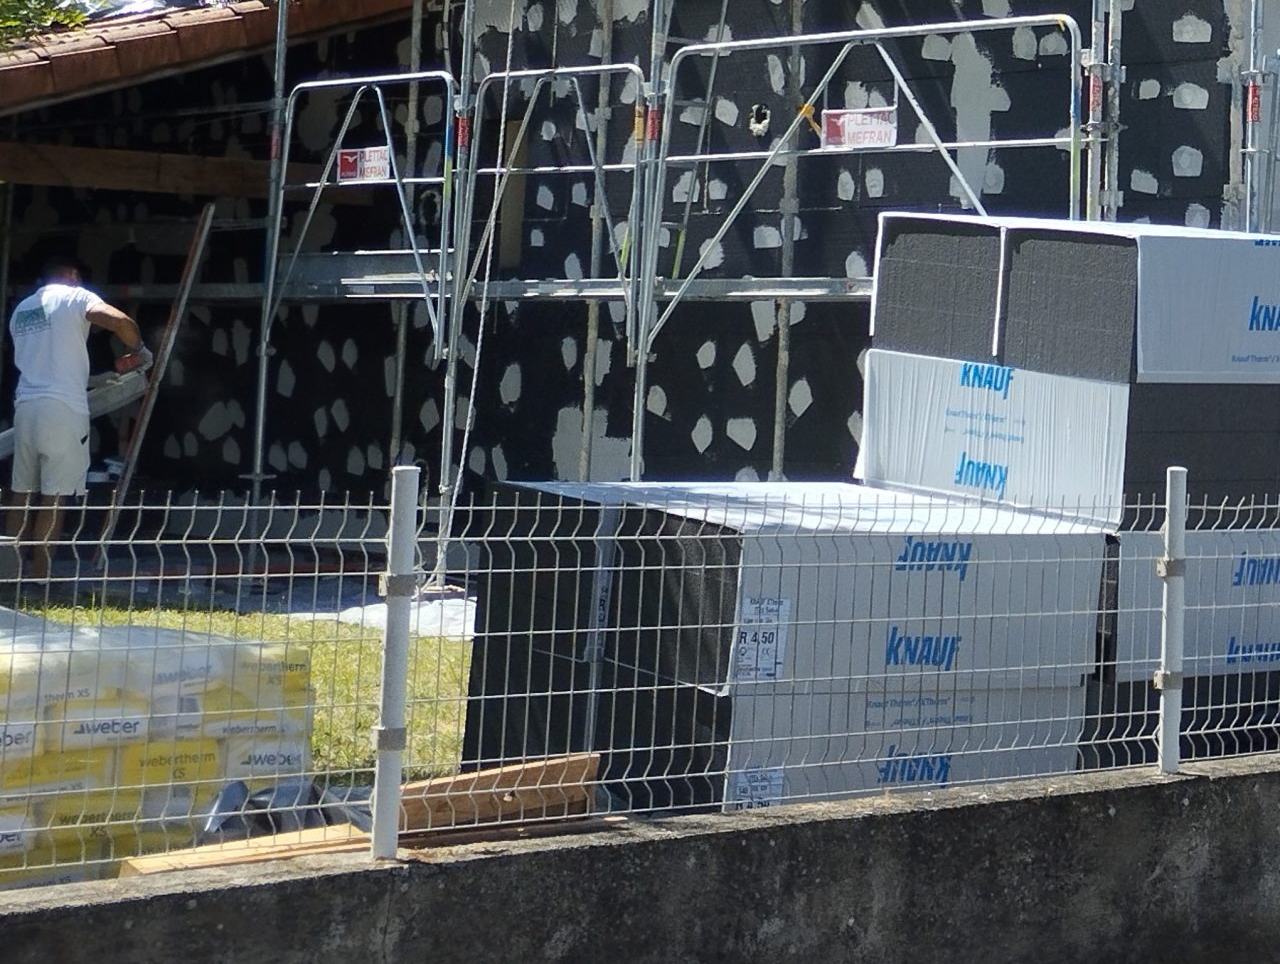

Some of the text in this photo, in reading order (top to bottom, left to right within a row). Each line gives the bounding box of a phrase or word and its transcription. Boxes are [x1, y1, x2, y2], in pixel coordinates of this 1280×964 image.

[847, 111, 894, 126] PLETTAC
[847, 130, 891, 145] MEFRAN
[960, 362, 1015, 400] KNAUF
[954, 451, 1008, 500] KNAUF
[895, 535, 973, 582] KNAUF
[740, 631, 747, 644] R
[886, 626, 962, 672] KNAUF
[85, 719, 140, 734] weber
[877, 744, 953, 789] KNAUF
